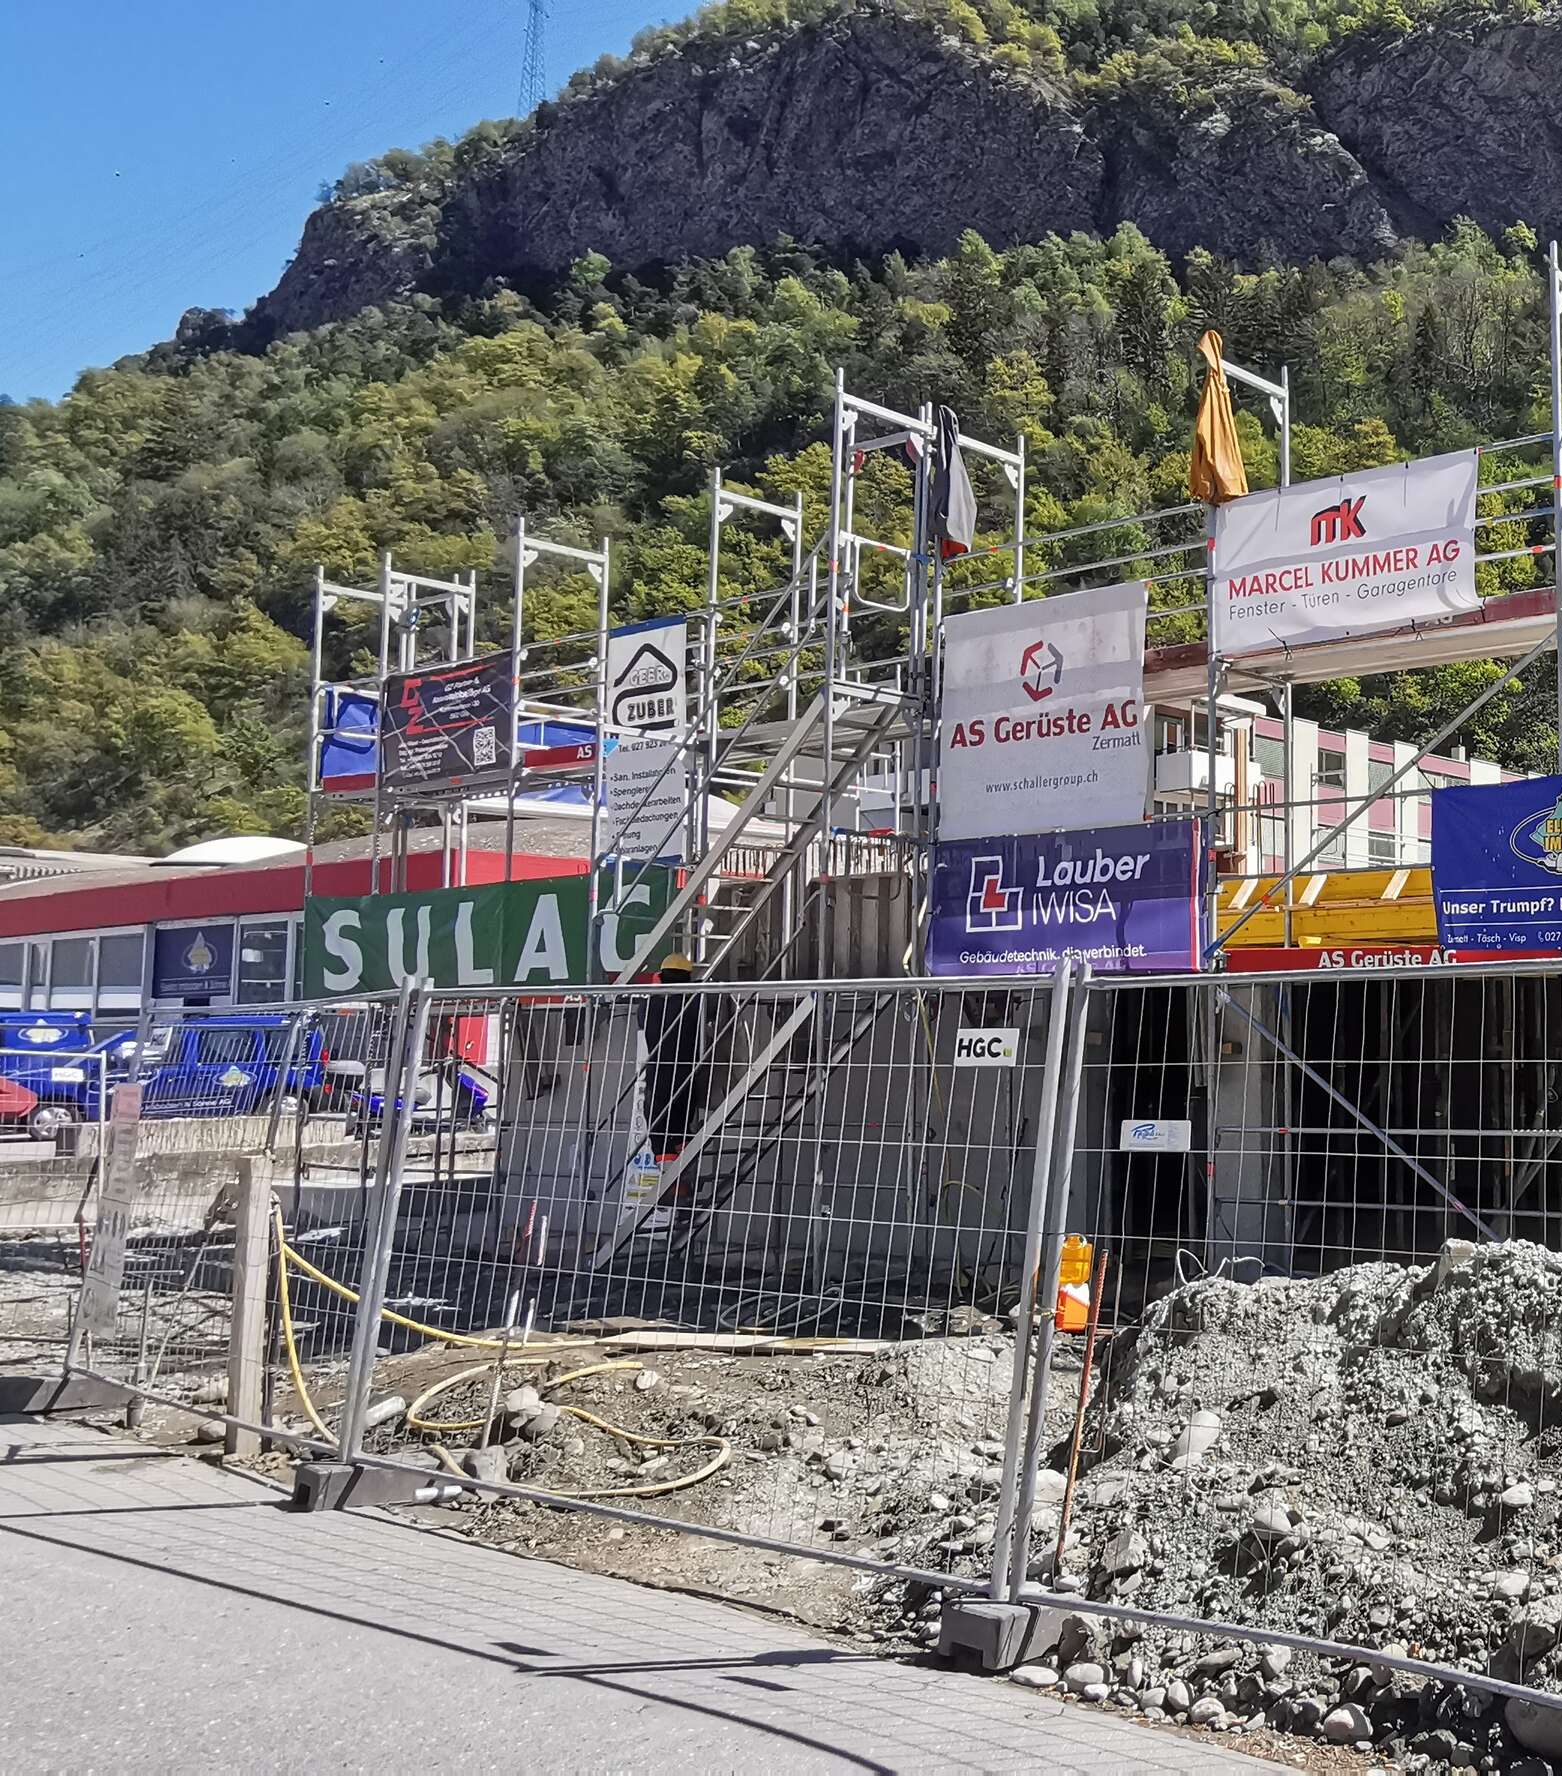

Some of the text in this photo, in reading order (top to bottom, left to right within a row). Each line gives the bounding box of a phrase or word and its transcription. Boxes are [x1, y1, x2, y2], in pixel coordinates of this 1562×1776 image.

[1229, 539, 1460, 600] MARCEL KUMMER AG
[1230, 600, 1286, 620] Fenster
[1301, 592, 1339, 609] Türen
[1357, 569, 1457, 600] Garagentore
[627, 697, 675, 722] ZUBER
[950, 699, 1138, 749] AS Gerüste AG
[576, 744, 593, 760] AS
[1092, 731, 1141, 750] Zermatt
[986, 769, 1099, 793] www.schallergroup.ch
[1036, 848, 1151, 887] Lauber
[1032, 888, 1117, 925] IWISA
[1442, 900, 1487, 915] Unser
[1490, 897, 1555, 916] Trumpf?
[322, 884, 653, 991] SULAG
[1477, 932, 1501, 943] Täsch
[1508, 932, 1527, 944] Visp
[1544, 931, 1561, 942] 027
[1318, 949, 1457, 968] AS Gerüste AG
[957, 1036, 1003, 1058] HGC
